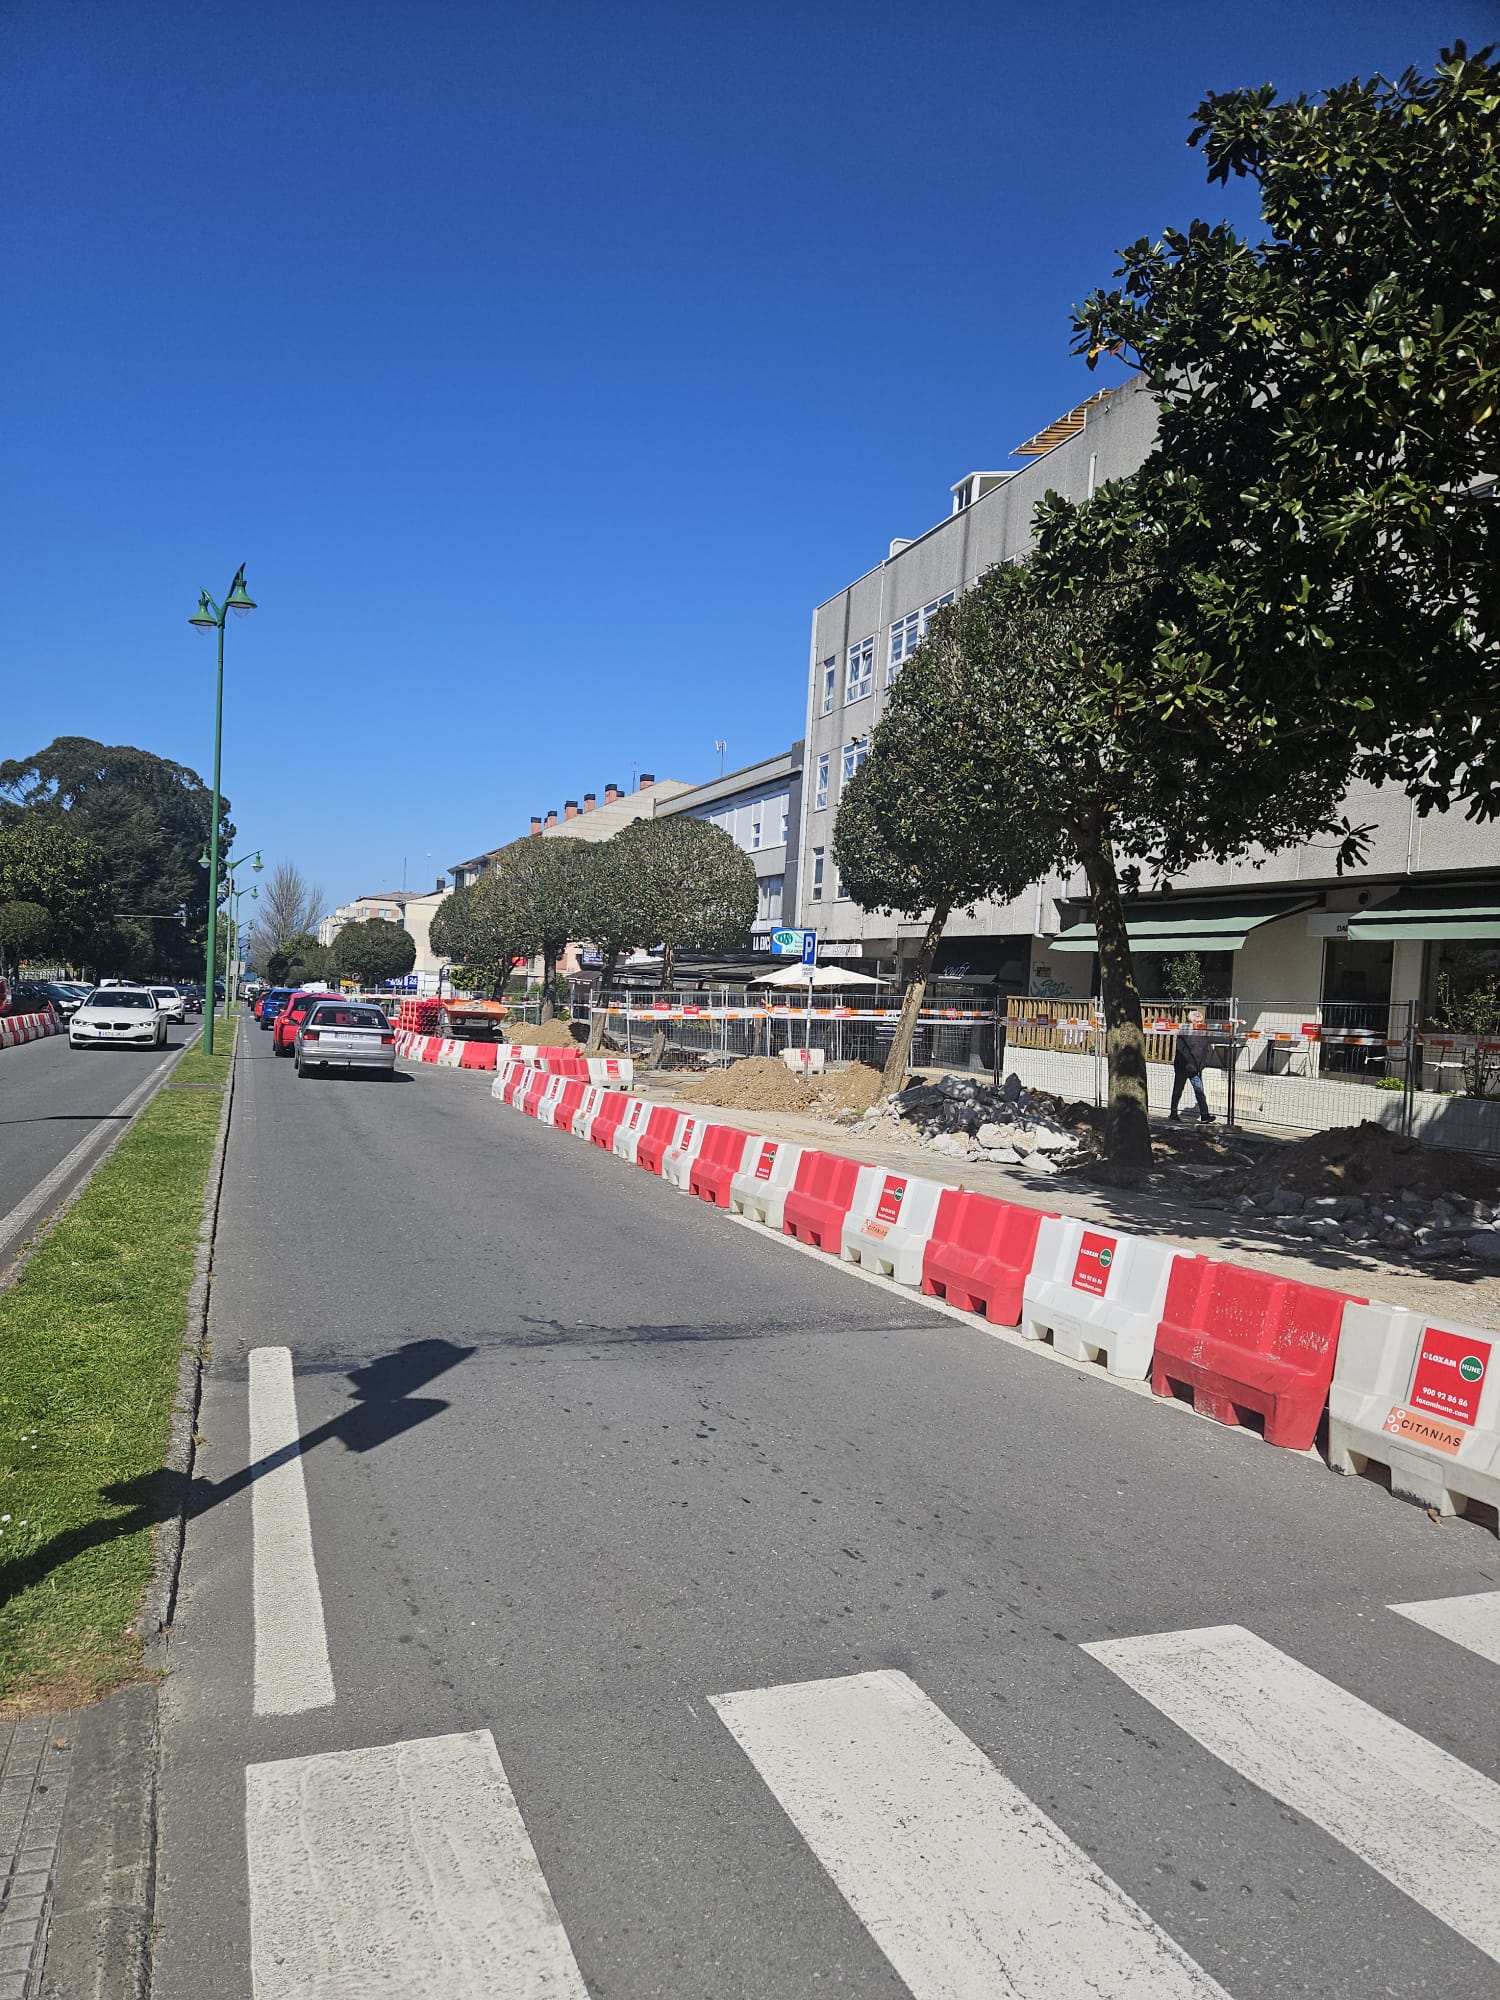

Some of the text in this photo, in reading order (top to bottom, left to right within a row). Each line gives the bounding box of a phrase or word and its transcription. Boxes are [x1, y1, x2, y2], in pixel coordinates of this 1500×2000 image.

[805, 936, 814, 962] P
[1428, 1353, 1482, 1375] LOXAM HUNE
[1422, 1386, 1468, 1407] 900 92 86 86
[1401, 1419, 1462, 1447] CITANIAS
